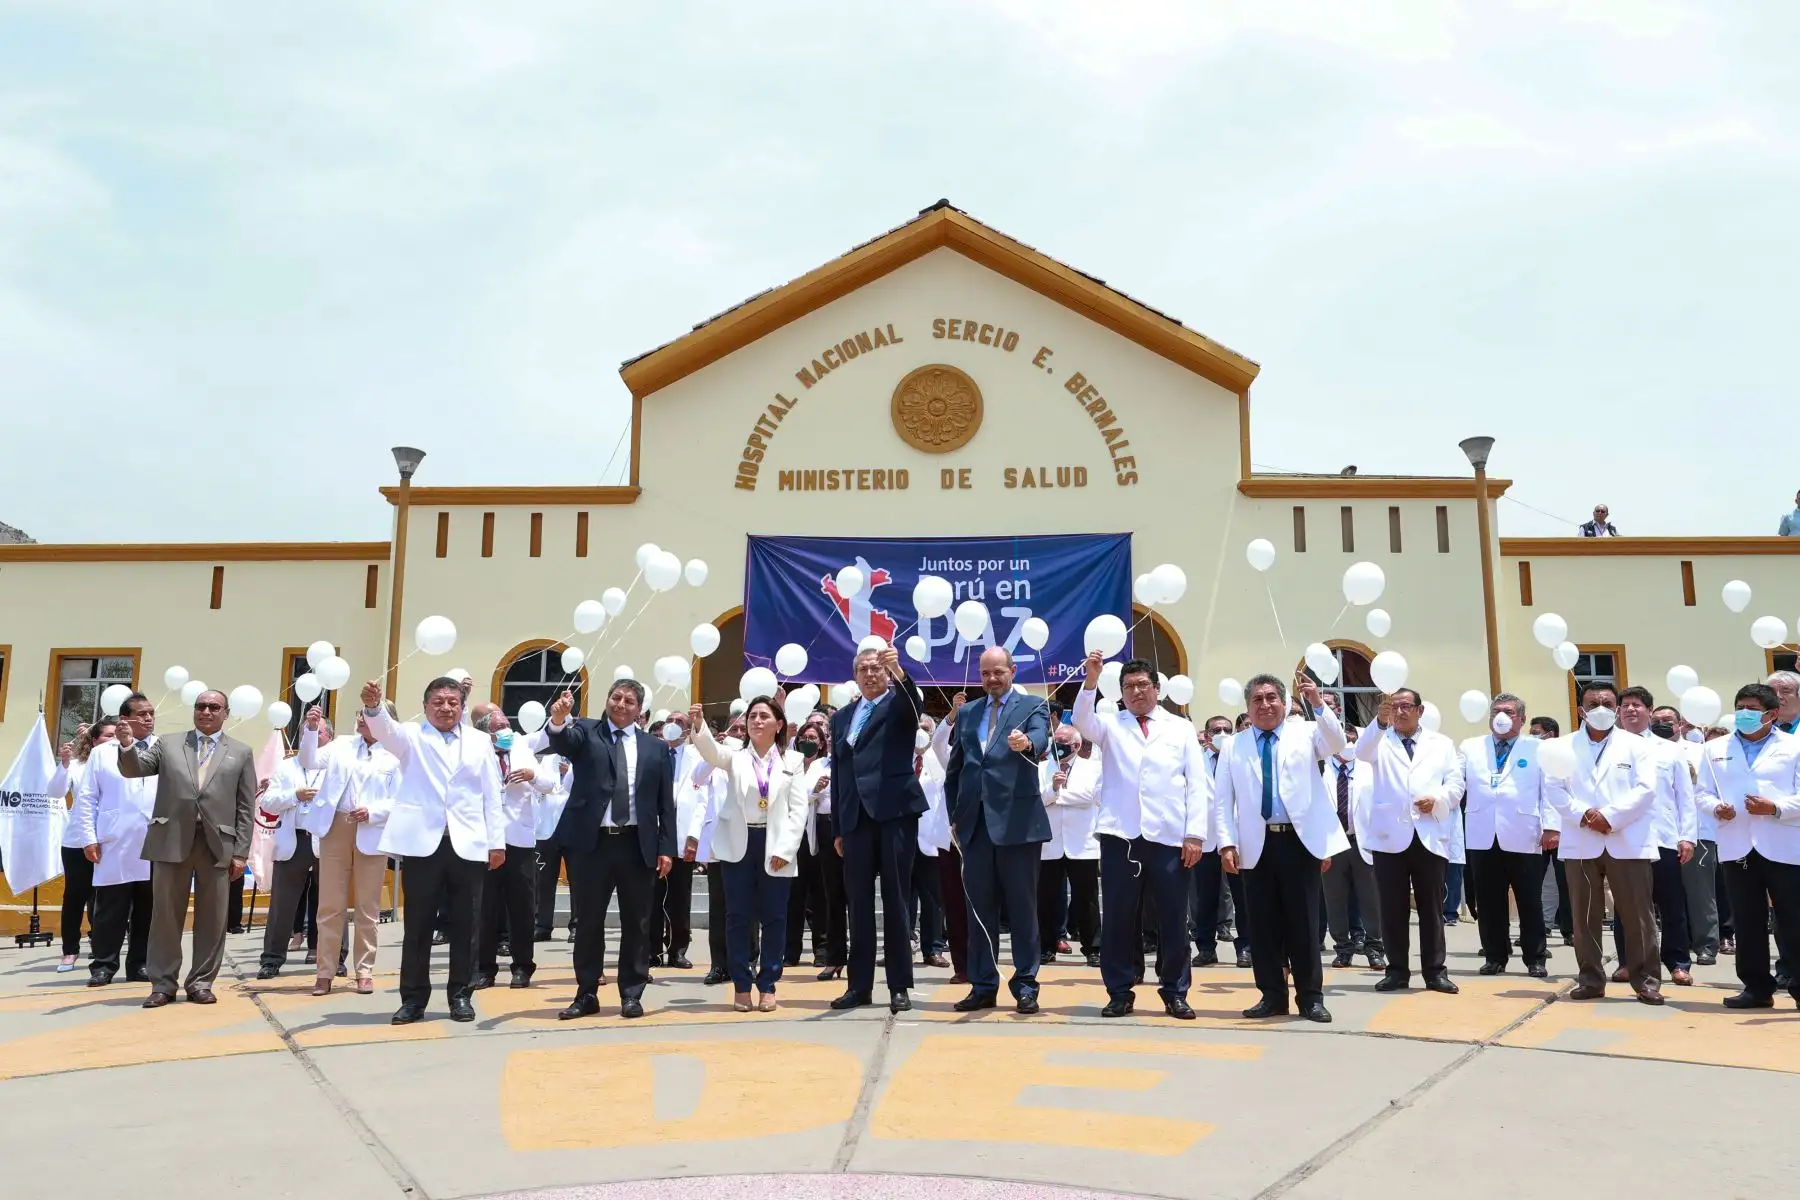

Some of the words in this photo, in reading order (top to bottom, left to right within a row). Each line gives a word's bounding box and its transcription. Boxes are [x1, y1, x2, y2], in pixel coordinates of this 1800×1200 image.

[734, 393, 798, 492] HOSPITAL
[795, 323, 904, 390] NACIONAL
[932, 317, 1021, 353] SERGIO
[1032, 345, 1054, 374] E.
[1064, 370, 1139, 487] BERNALES
[778, 467, 910, 492] MINISTERIO
[940, 467, 973, 491] DE
[1003, 465, 1088, 490] SALUD
[918, 556, 973, 571] Juntos
[978, 559, 1005, 575] por
[1010, 559, 1030, 571] un
[995, 579, 1031, 600] en
[500, 1034, 1264, 1156] DE
